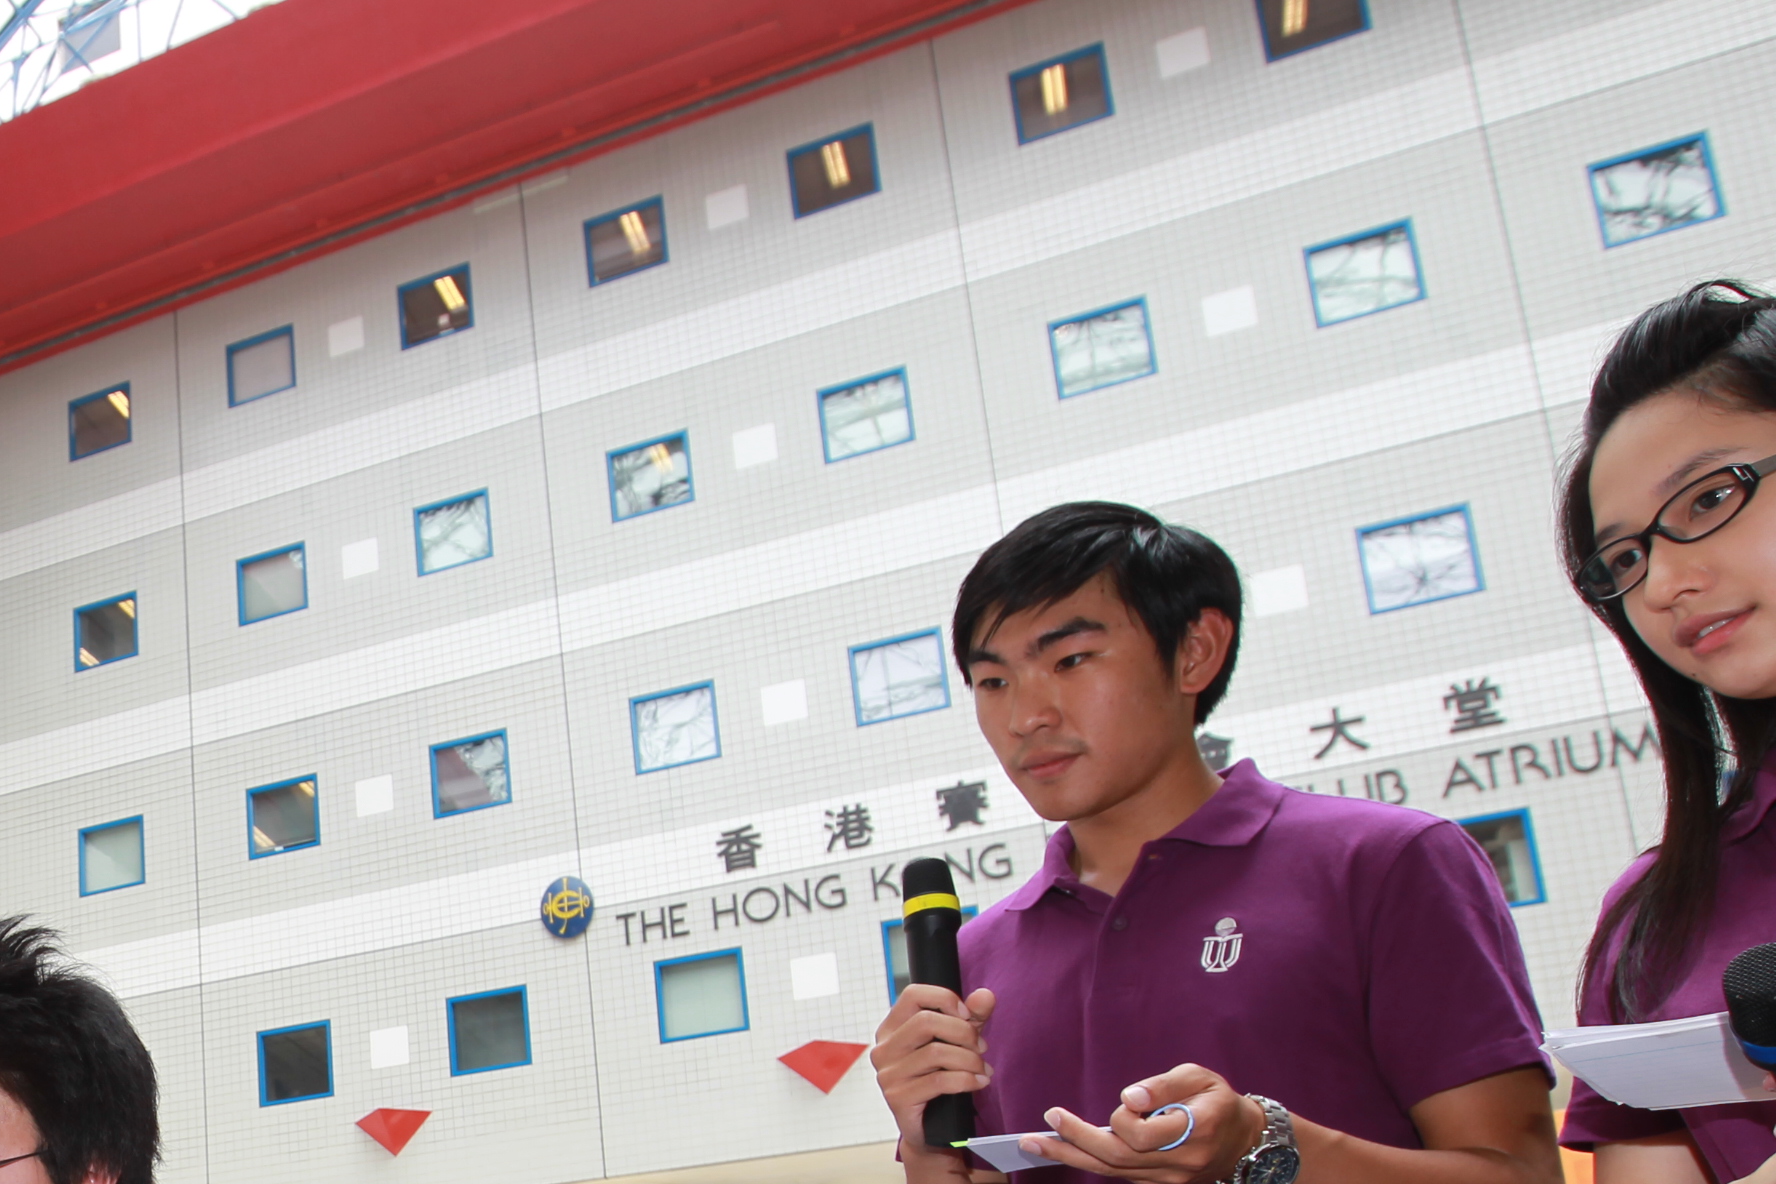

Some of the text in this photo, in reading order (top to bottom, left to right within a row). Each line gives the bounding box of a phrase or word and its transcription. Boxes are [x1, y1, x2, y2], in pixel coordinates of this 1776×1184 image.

[615, 902, 691, 946] THE
[711, 873, 848, 931] HONG
[870, 842, 1014, 902] KNG
[1442, 720, 1661, 799] ATRIUM
